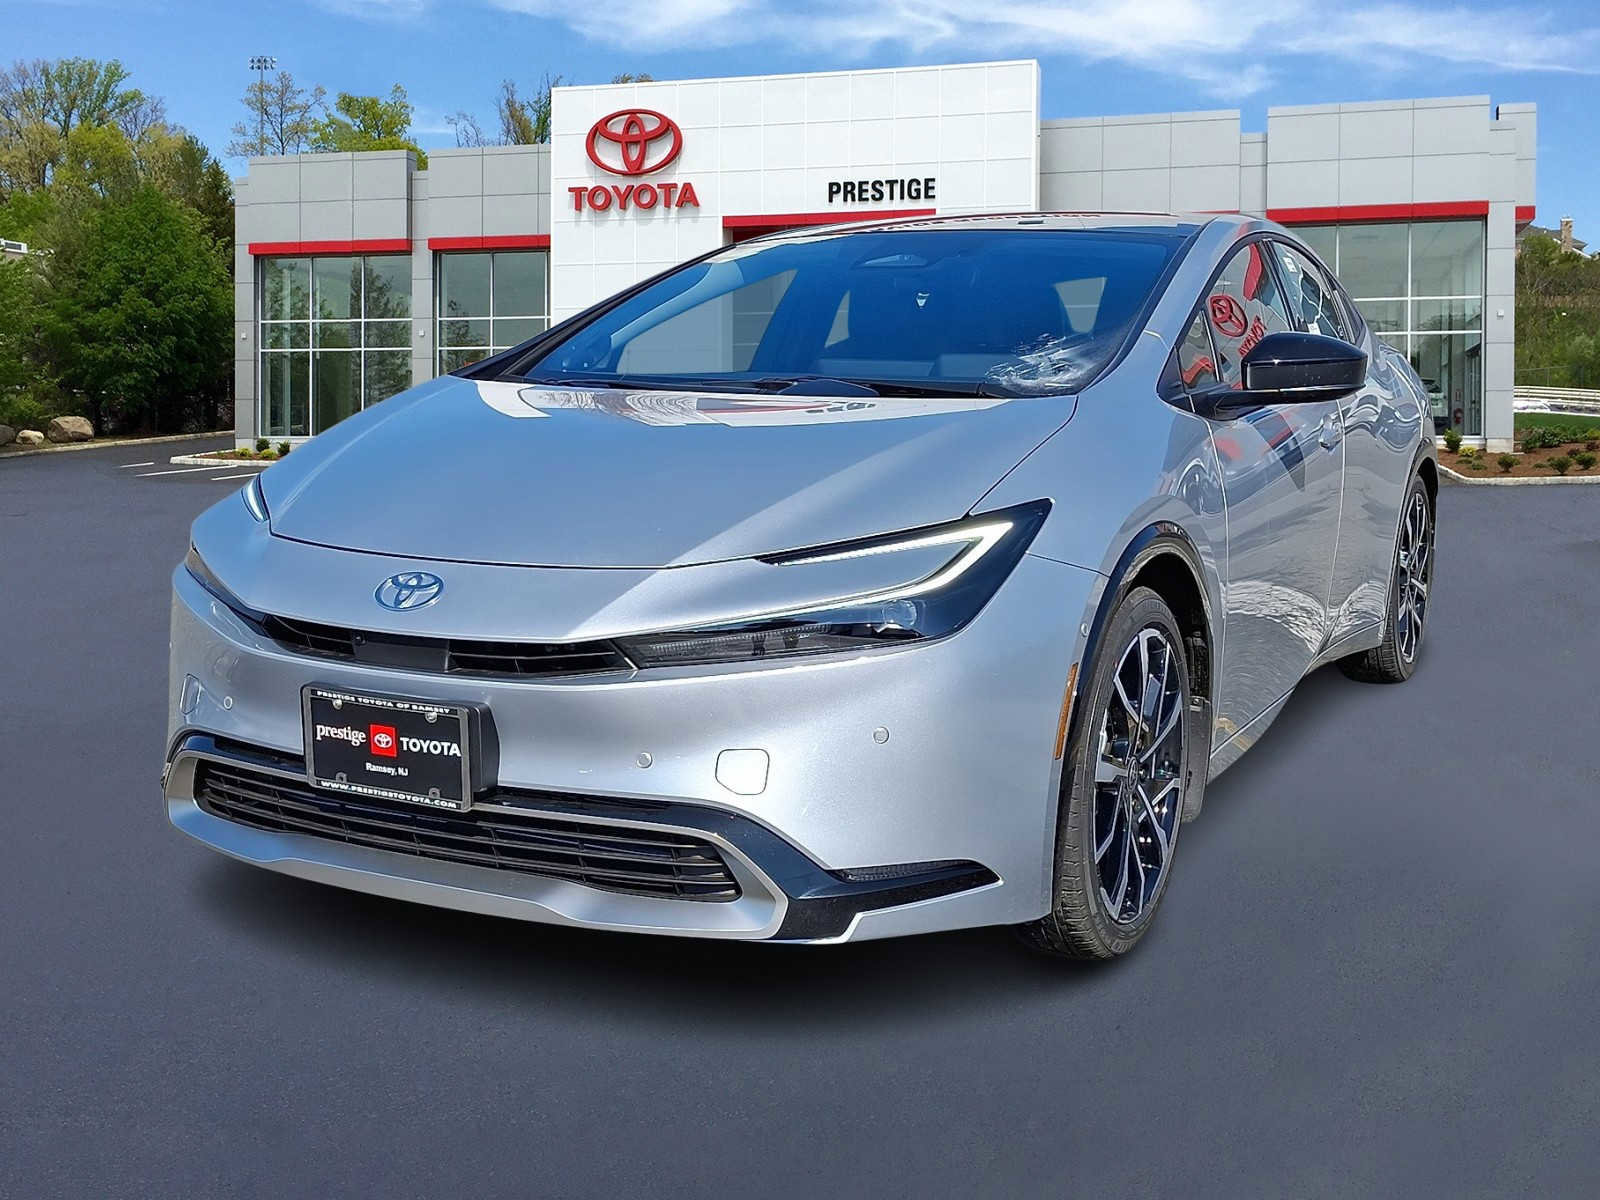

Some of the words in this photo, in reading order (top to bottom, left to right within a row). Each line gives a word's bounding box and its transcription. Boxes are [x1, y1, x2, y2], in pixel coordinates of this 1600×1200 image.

[568, 182, 700, 212] TOYOTA
[828, 177, 937, 203] PRESTIGE
[316, 690, 356, 702] PRESTIGE
[357, 697, 394, 708] TOYOTA
[395, 702, 410, 710] OF
[411, 704, 451, 714] RAMSEY
[316, 724, 367, 747] prestige
[400, 736, 462, 758] TOYOTA
[365, 762, 397, 776] Ramsey,
[398, 767, 409, 776] NJ
[320, 780, 457, 809] WWW.PRESTIGETOYOTA.COM
